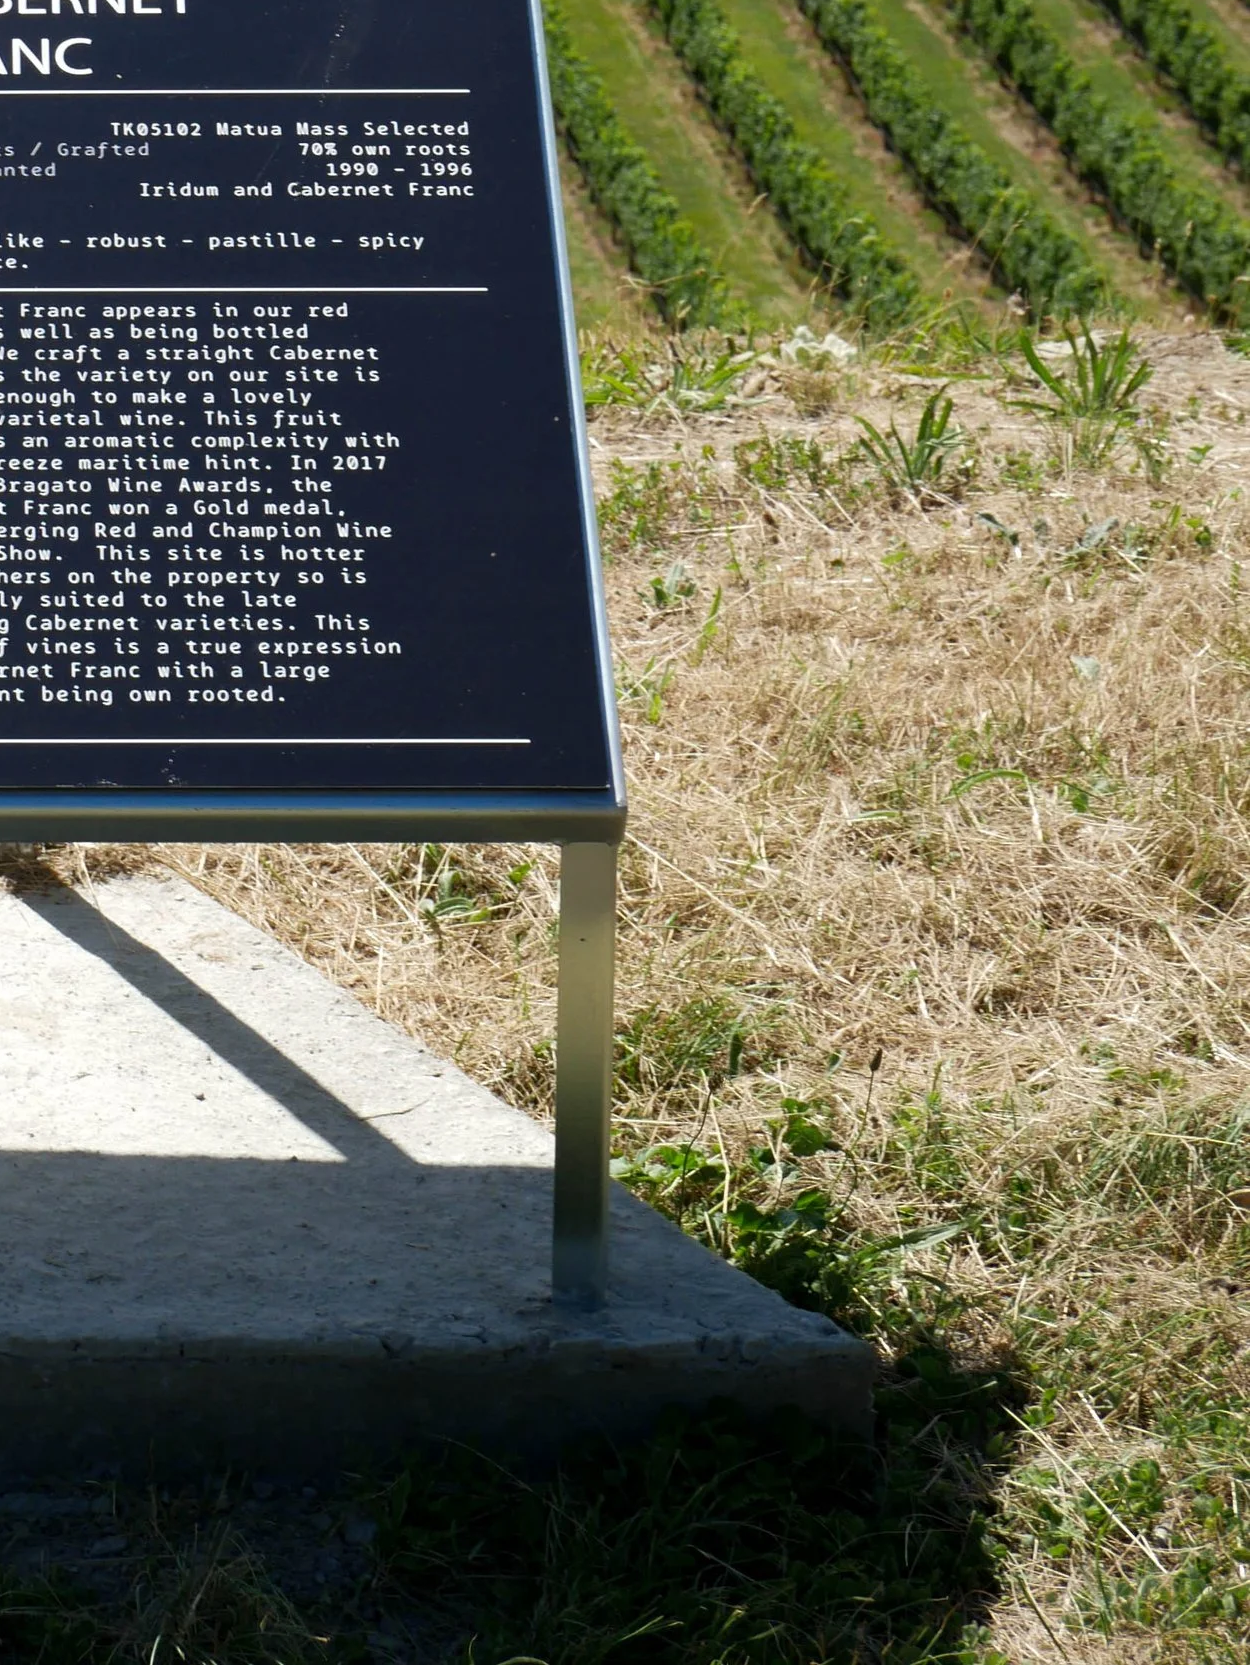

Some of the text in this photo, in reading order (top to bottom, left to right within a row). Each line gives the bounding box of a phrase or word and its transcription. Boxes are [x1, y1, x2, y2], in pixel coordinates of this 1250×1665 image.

[110, 121, 469, 136] TK05102 Matua Mass Selected
[57, 142, 149, 159] Grafted
[299, 142, 470, 156] 70% own roots
[326, 162, 378, 176] 1990
[420, 162, 472, 176] 1996
[140, 182, 474, 197] Iridum and Cabernet Franc
[87, 233, 166, 248] robust
[209, 232, 315, 250] pastille
[359, 233, 424, 250] spicy
[20, 303, 86, 318] Franc
[102, 306, 196, 320] appears
[213, 302, 238, 317] in
[253, 306, 292, 317] our
[309, 302, 348, 317] red
[20, 323, 73, 339] well
[89, 328, 114, 339] as
[130, 323, 198, 342] being
[213, 323, 308, 339] bottled
[35, 345, 102, 363] craft
[118, 349, 129, 360] a
[146, 345, 254, 363] straight
[270, 345, 379, 360] Cabernet
[21, 367, 60, 382] the
[77, 366, 171, 385] variety
[188, 370, 214, 382] on
[229, 370, 269, 382] our
[286, 366, 338, 382] site
[355, 366, 380, 382] is
[91, 391, 117, 404] to
[132, 388, 186, 403] make
[203, 392, 214, 403] a
[231, 388, 311, 406] lovely
[119, 410, 185, 426] wine.
[204, 410, 257, 425] This
[274, 410, 342, 429] fruit
[22, 436, 48, 448] an
[64, 432, 174, 448] aromatic
[191, 432, 328, 451] complexity
[345, 432, 399, 447] with
[78, 454, 189, 470] maritime
[205, 454, 271, 470] hint.
[291, 455, 317, 470] In
[333, 455, 386, 470] 2017
[108, 476, 162, 492] Wine
[292, 477, 332, 492] the
[24, 500, 92, 515] Franc
[109, 503, 149, 515] won
[166, 503, 177, 515] a
[194, 499, 248, 515] Gold
[95, 522, 136, 538] Red
[152, 522, 193, 538] and
[209, 522, 321, 541] Champion
[336, 522, 392, 538] Wine
[96, 544, 150, 561] This
[168, 544, 222, 561] site
[240, 544, 265, 561] is
[281, 544, 365, 561] hotter
[68, 572, 94, 584] on
[111, 568, 151, 584] the
[168, 570, 280, 587] property
[298, 572, 324, 584] so
[341, 567, 366, 584] is
[40, 591, 124, 607] suited
[140, 593, 167, 607] to
[184, 591, 224, 607] the
[242, 590, 296, 607] late
[26, 614, 139, 631] Cabernet
[156, 614, 295, 631] varieties.
[315, 614, 370, 630] This
[27, 637, 96, 654] vines
[114, 637, 139, 654] is
[157, 642, 169, 654] a
[186, 640, 241, 654] true
[258, 637, 401, 657] expression
[71, 662, 140, 678] Franc
[157, 661, 214, 678] with
[231, 666, 243, 678] a
[259, 661, 330, 682] large
[42, 685, 113, 706] being
[129, 690, 171, 702] own
[188, 685, 285, 702] rooted.
